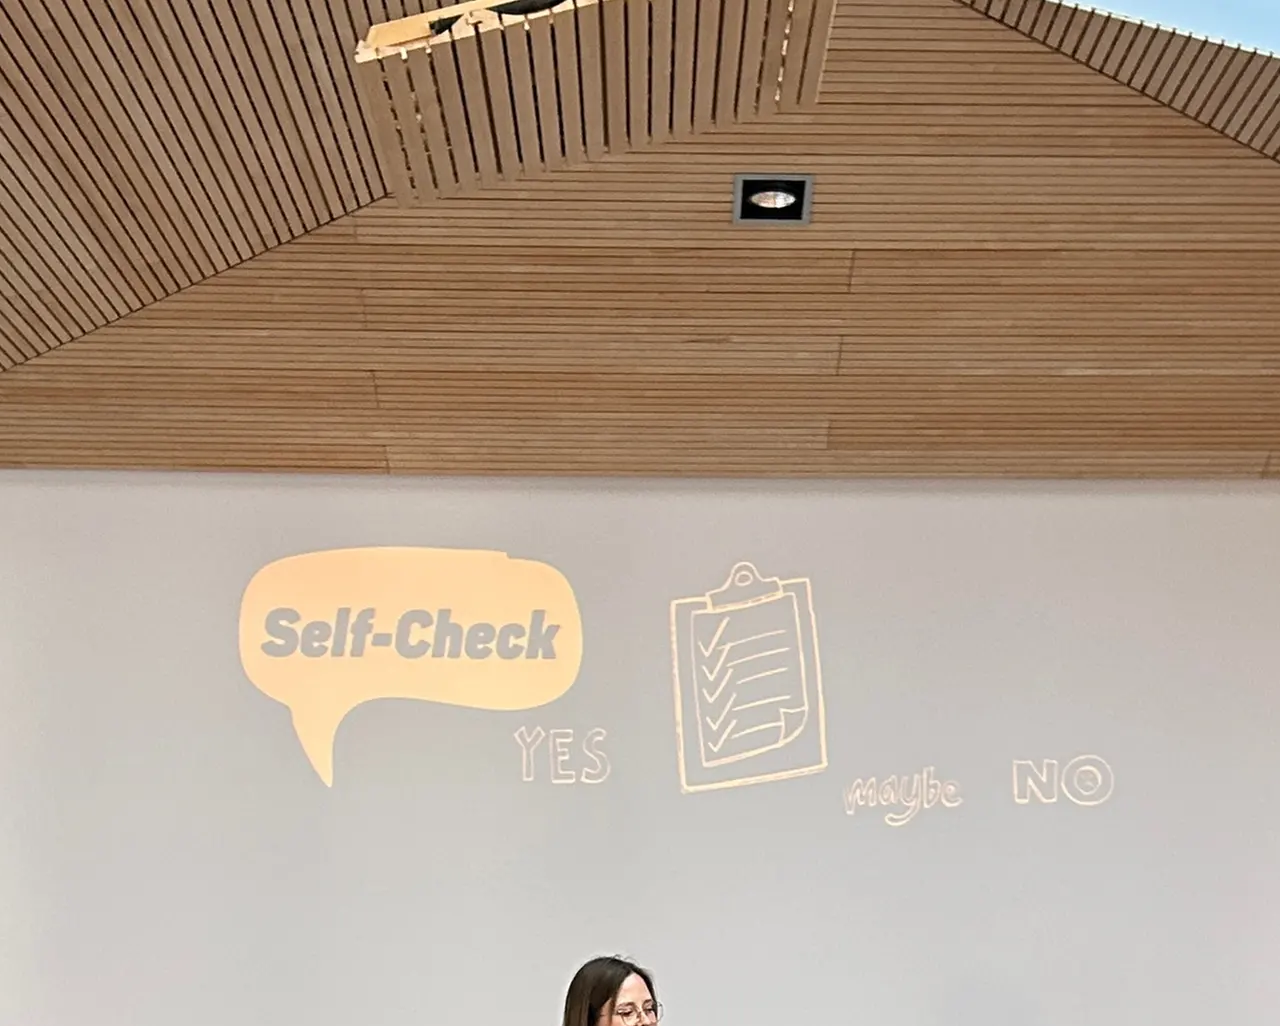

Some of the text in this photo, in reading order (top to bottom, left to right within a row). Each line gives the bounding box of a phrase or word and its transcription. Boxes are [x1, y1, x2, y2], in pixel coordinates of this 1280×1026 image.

[260, 607, 561, 659] Self-Check
[513, 725, 612, 784] YES
[1012, 754, 1115, 806] NO
[843, 765, 964, 826] maybe
